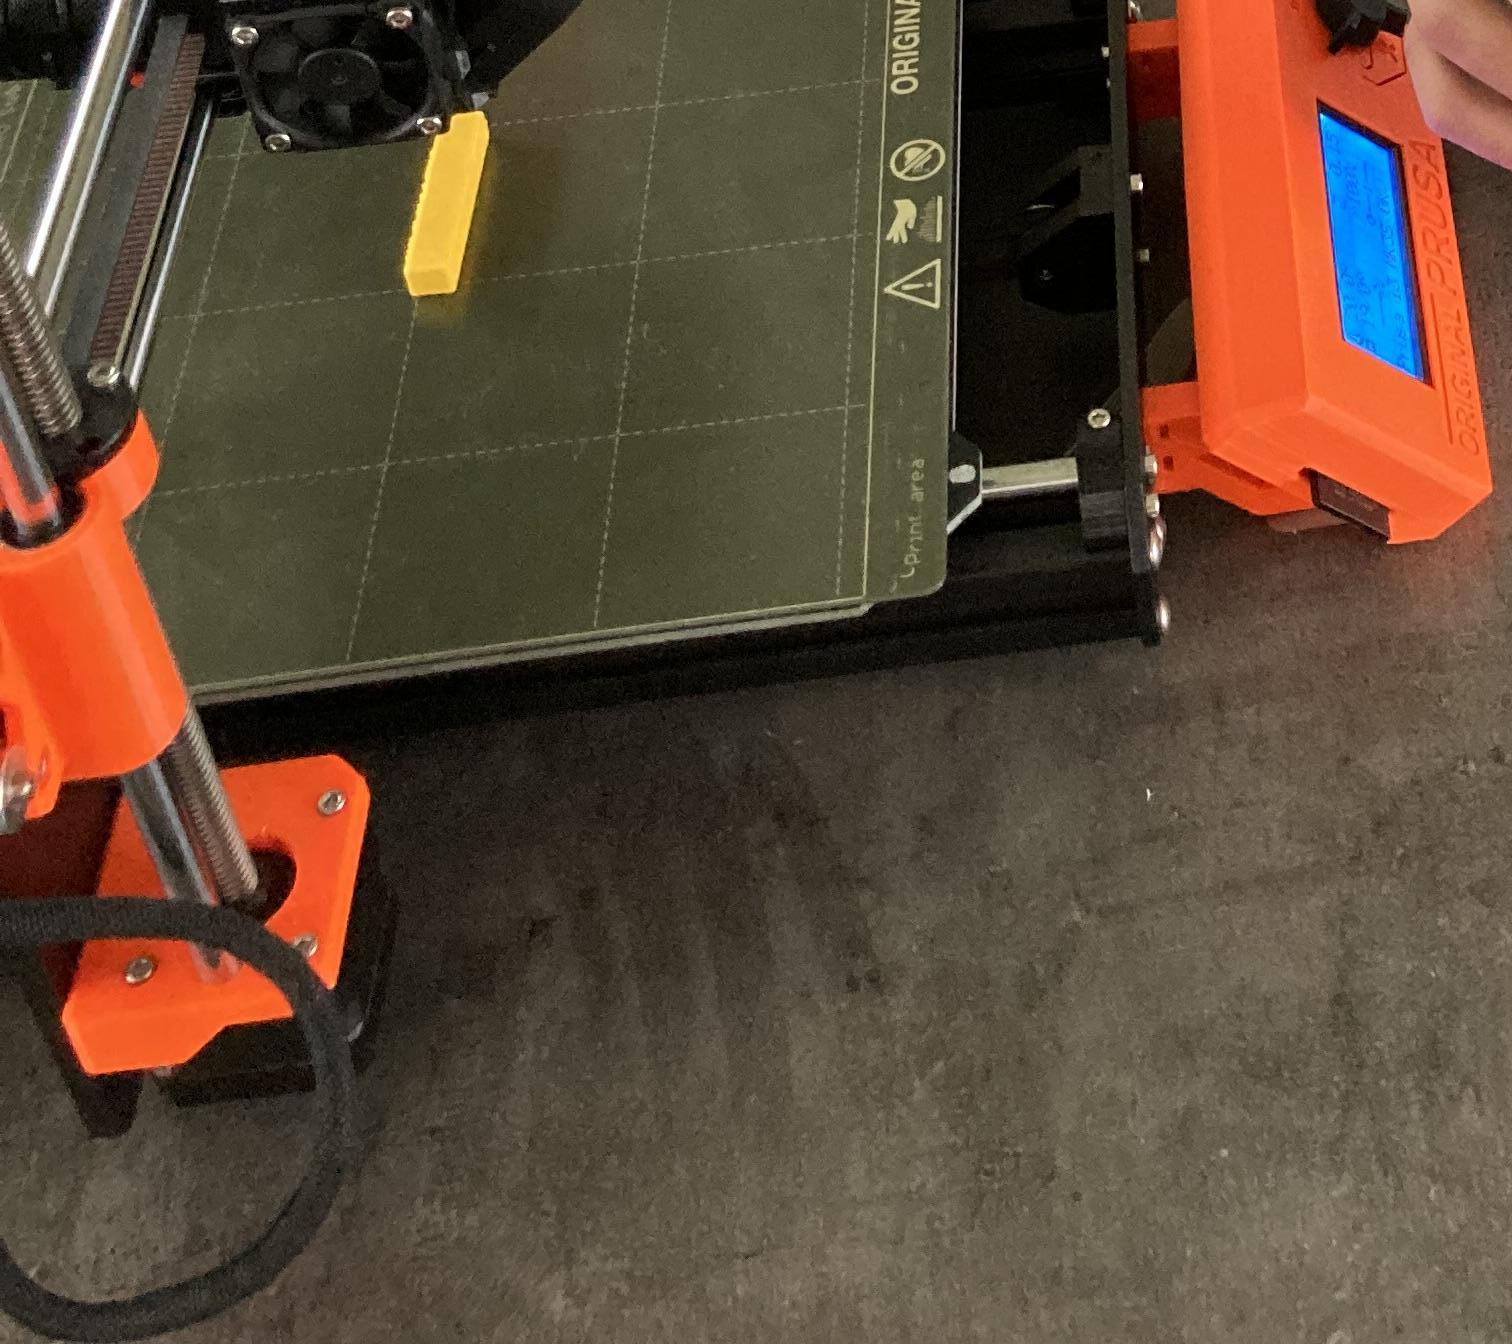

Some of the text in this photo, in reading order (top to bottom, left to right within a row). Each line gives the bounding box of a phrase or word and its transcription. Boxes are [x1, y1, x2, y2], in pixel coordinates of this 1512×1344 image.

[1408, 139, 1480, 456] ORIGINAL PRUSA
[911, 458, 925, 503] area
